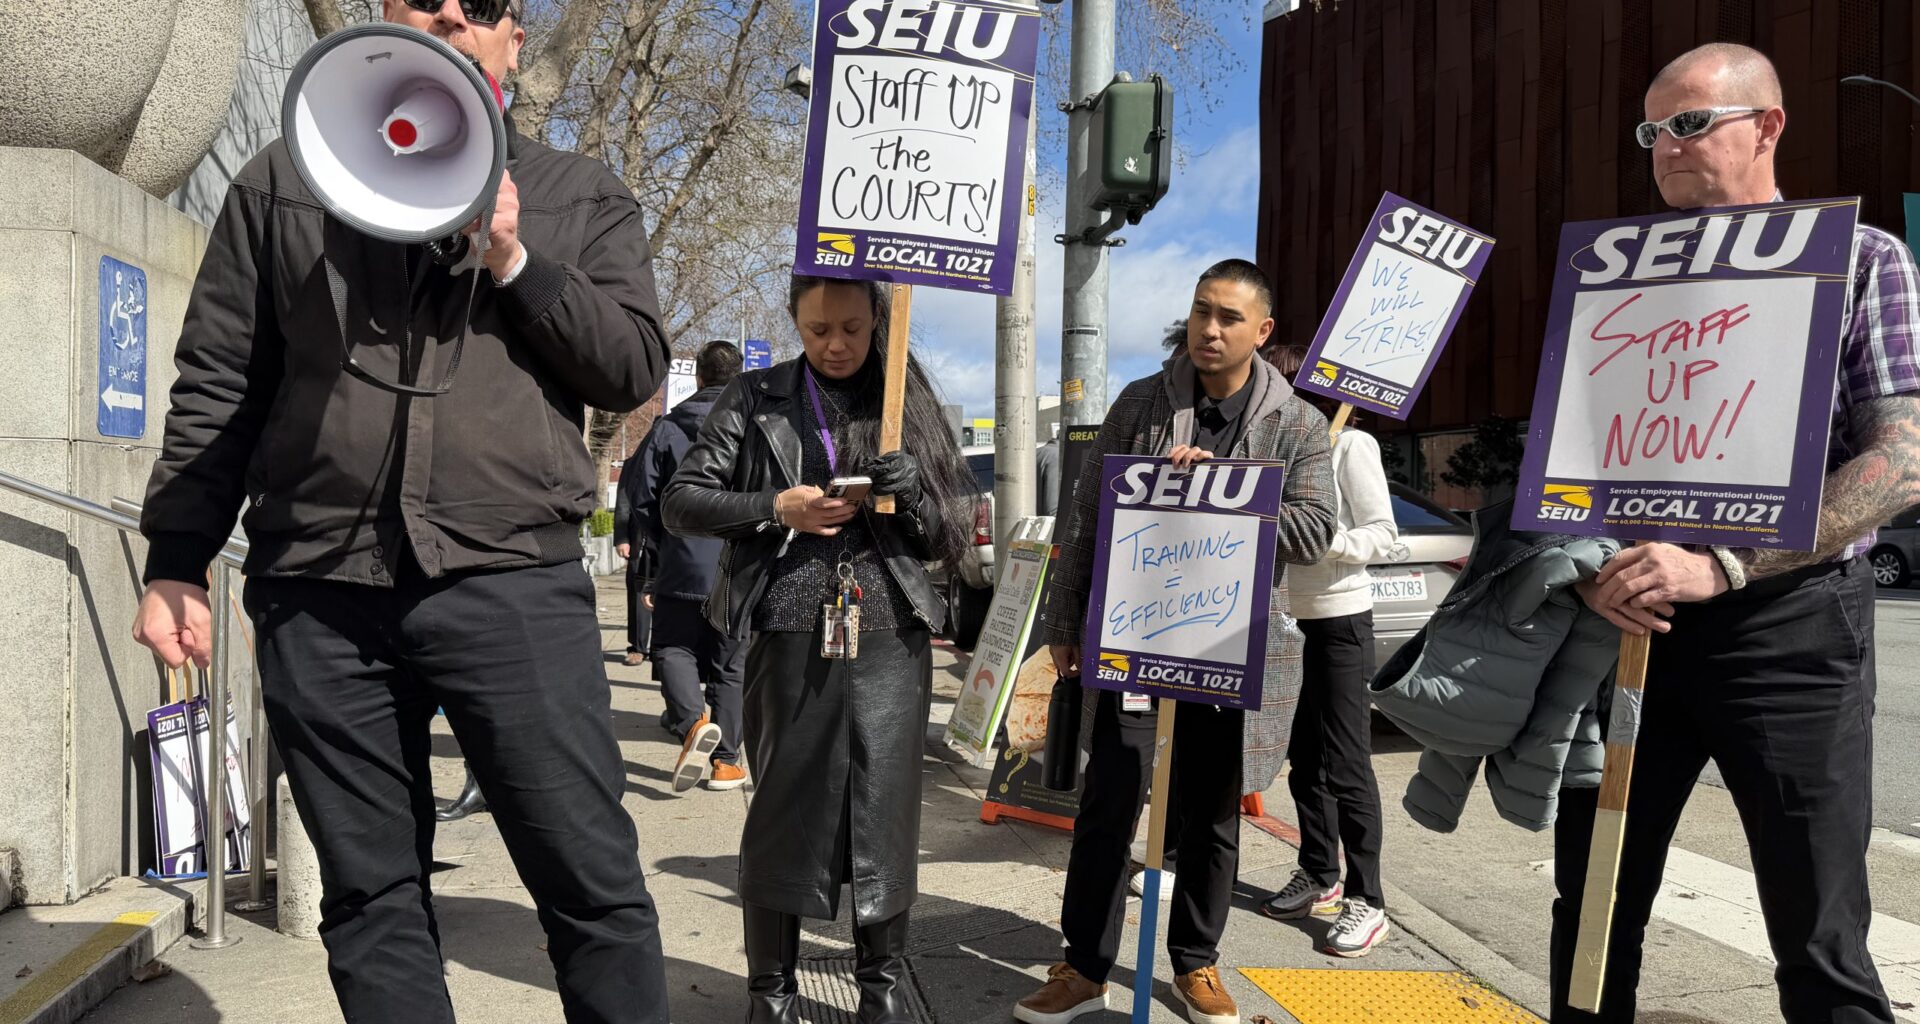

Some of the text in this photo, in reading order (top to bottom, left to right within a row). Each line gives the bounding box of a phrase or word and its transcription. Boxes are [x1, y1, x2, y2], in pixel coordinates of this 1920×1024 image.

[836, 0, 1017, 60] SEIU
[836, 64, 1001, 130] Staff UP
[870, 136, 931, 172] the
[832, 166, 996, 237] COURTS!
[867, 236, 995, 257] Service Employees International Union
[1378, 206, 1484, 269] SEIU
[1579, 207, 1821, 285] SEIU
[814, 252, 855, 267] SEIU
[866, 245, 994, 274] LOCAL 1021
[1372, 258, 1413, 291] WE
[1370, 291, 1424, 316] WILL
[1339, 306, 1449, 357] STRIKE!
[1589, 292, 1750, 376] STAFF
[669, 358, 697, 376] SEI
[1308, 374, 1334, 388] SEIU
[1647, 359, 1719, 404] UP
[1339, 377, 1380, 398] LOCAL
[1380, 389, 1406, 406] 1021
[1602, 379, 1756, 469] NOW!
[1116, 462, 1264, 509] SEIU
[1609, 487, 1786, 502] Service Employees International Union
[1537, 506, 1590, 522] SEIU
[1606, 497, 1783, 525] LOCAL 1021
[1116, 522, 1245, 572] TRAINING
[1371, 581, 1422, 598] 9KCS783
[1109, 580, 1240, 636] EFFICIENCY
[1096, 669, 1128, 682] SEIU
[1137, 665, 1243, 691] LOCAL 1021
[1158, 659, 1187, 669] Employees
[1188, 663, 1225, 673] International
